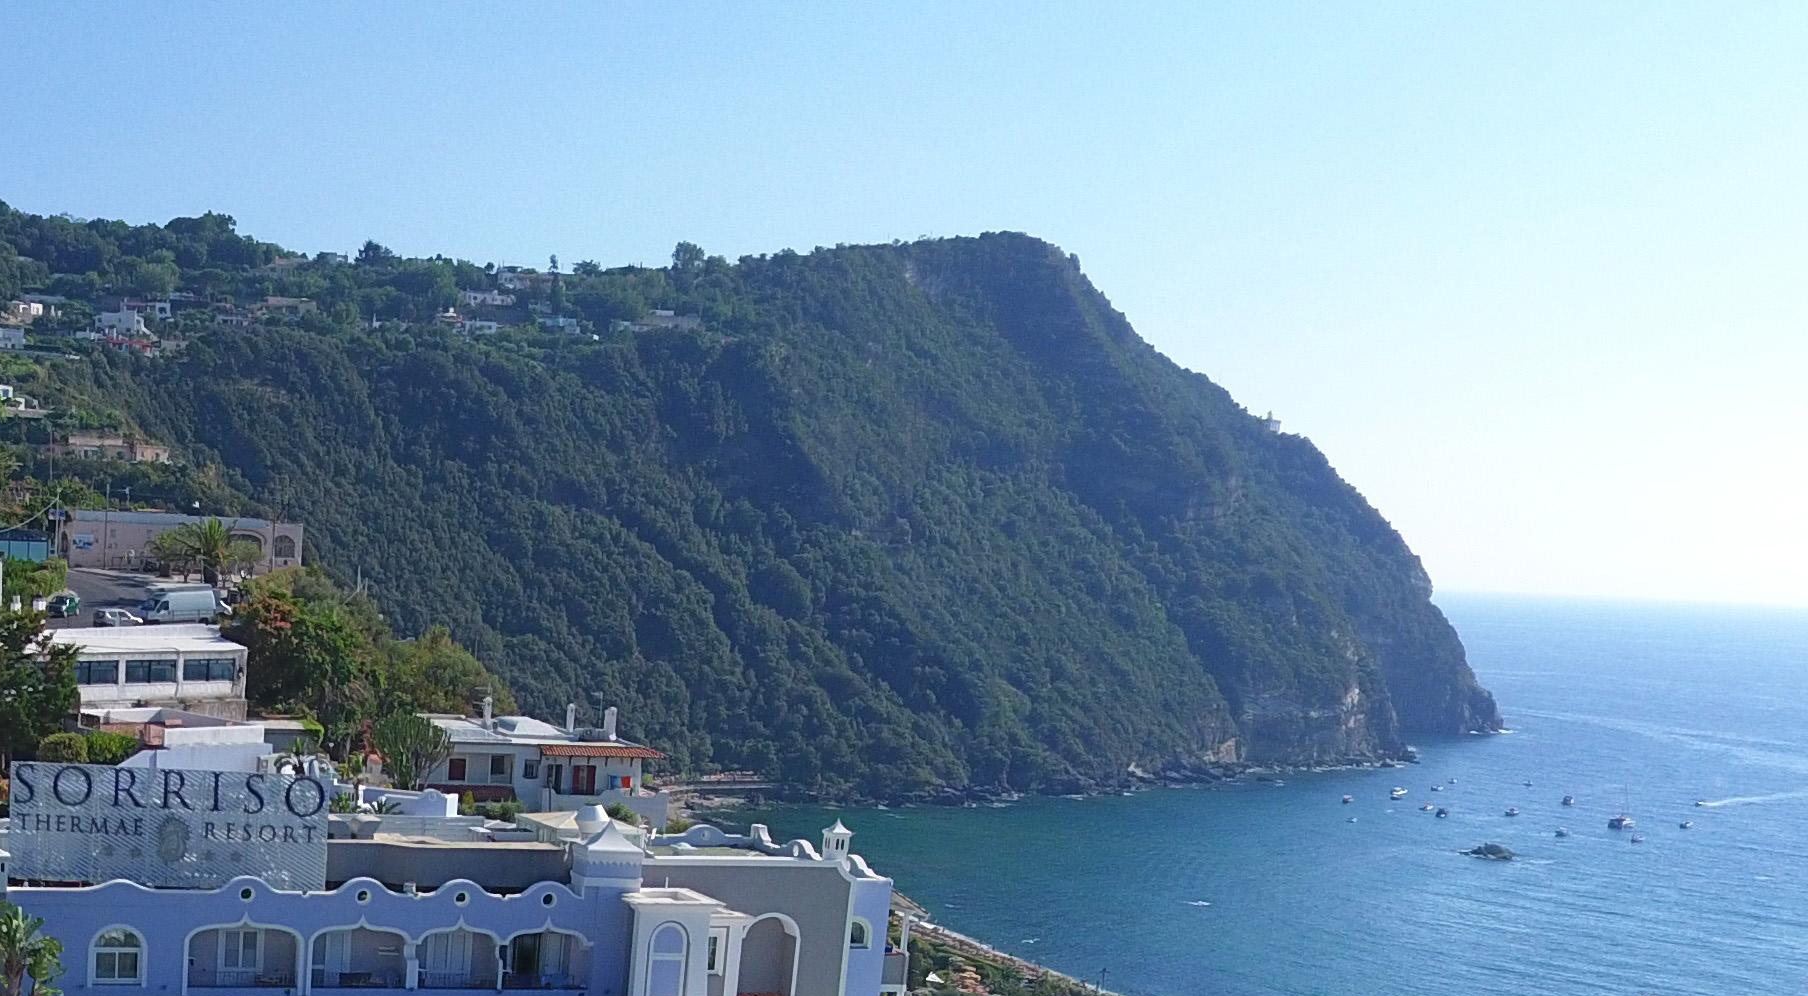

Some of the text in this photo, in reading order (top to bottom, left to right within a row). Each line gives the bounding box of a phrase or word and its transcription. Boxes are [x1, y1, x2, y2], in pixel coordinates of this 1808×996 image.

[13, 763, 326, 818] SORRISO
[16, 811, 318, 844] THERMAE RESORT
